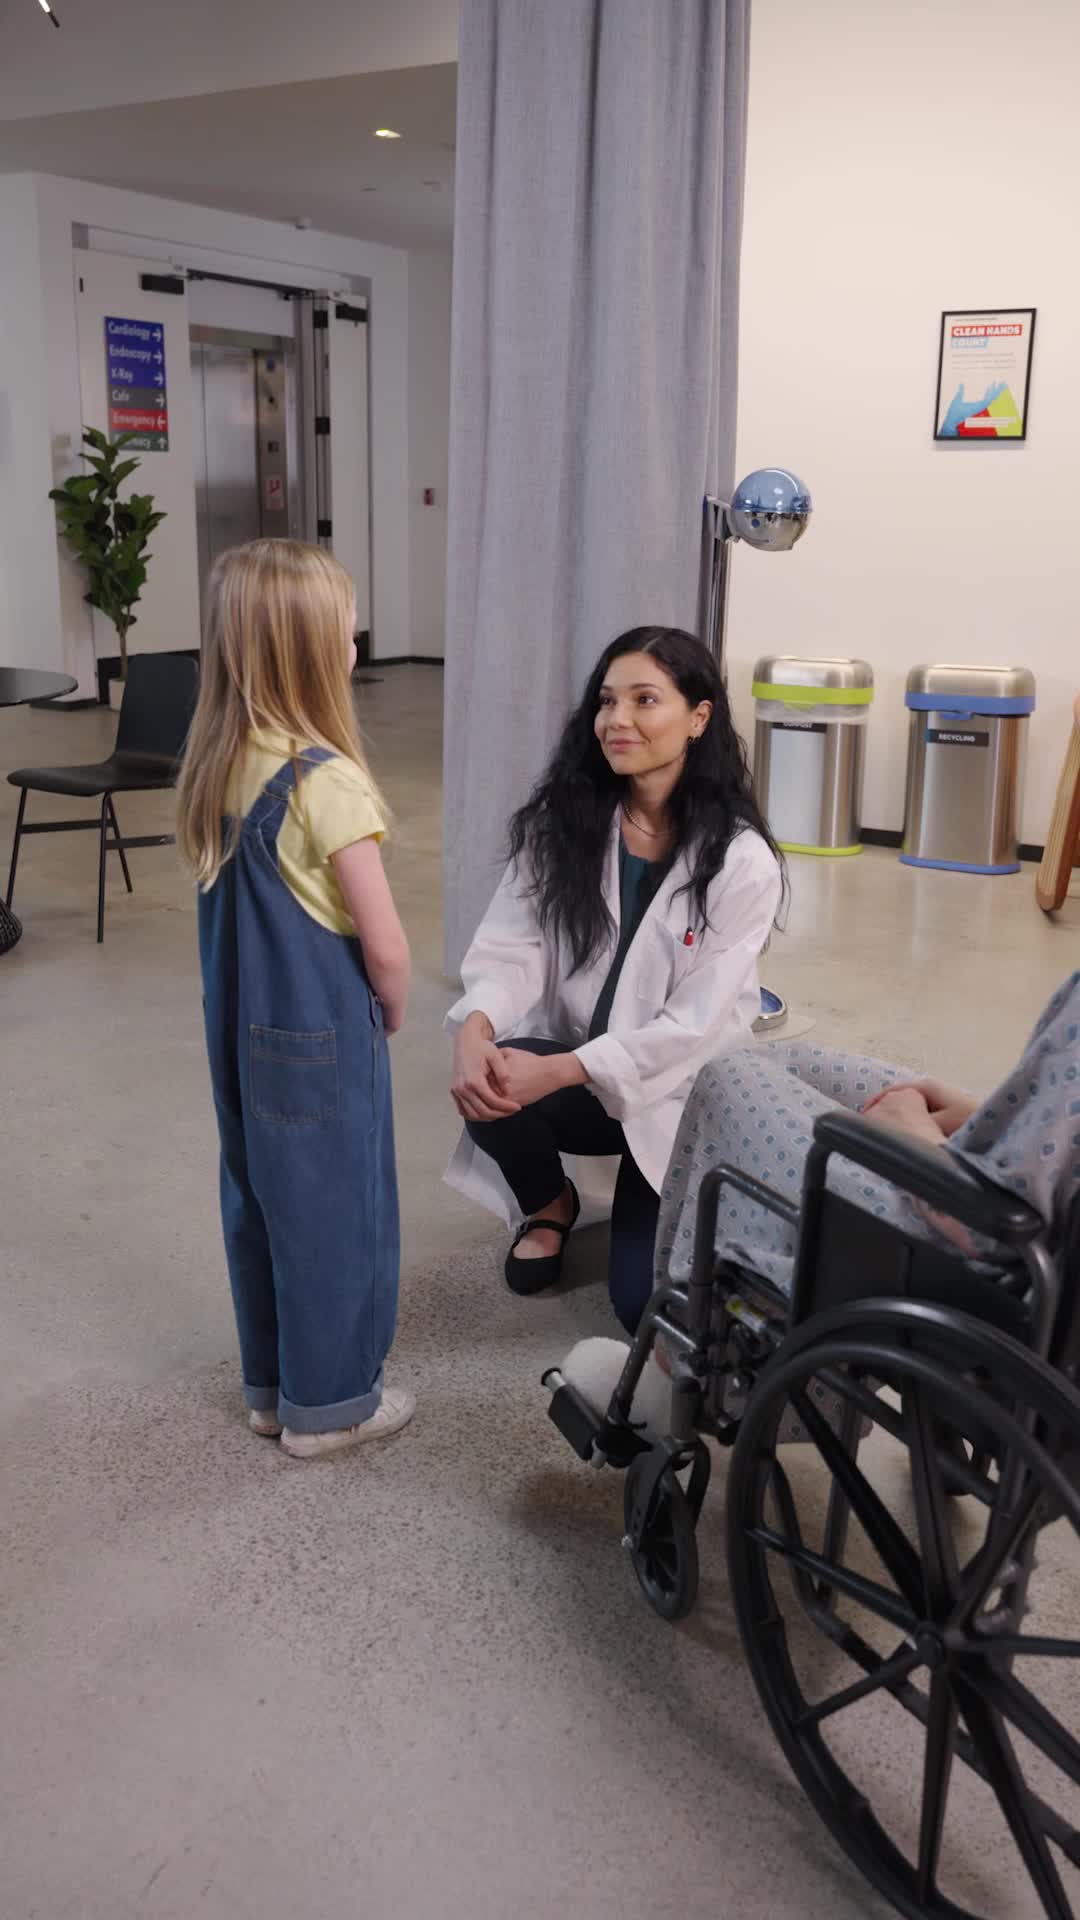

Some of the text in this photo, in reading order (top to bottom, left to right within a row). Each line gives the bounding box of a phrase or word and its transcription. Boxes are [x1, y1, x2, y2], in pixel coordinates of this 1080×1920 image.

[108, 322, 150, 341] Cardiology
[953, 325, 1019, 336] CLEAN HANDS
[109, 344, 151, 363] Endoscopy
[111, 367, 133, 383] X-Ray
[113, 412, 155, 428] Emergency
[938, 733, 976, 742] RECYCLING
